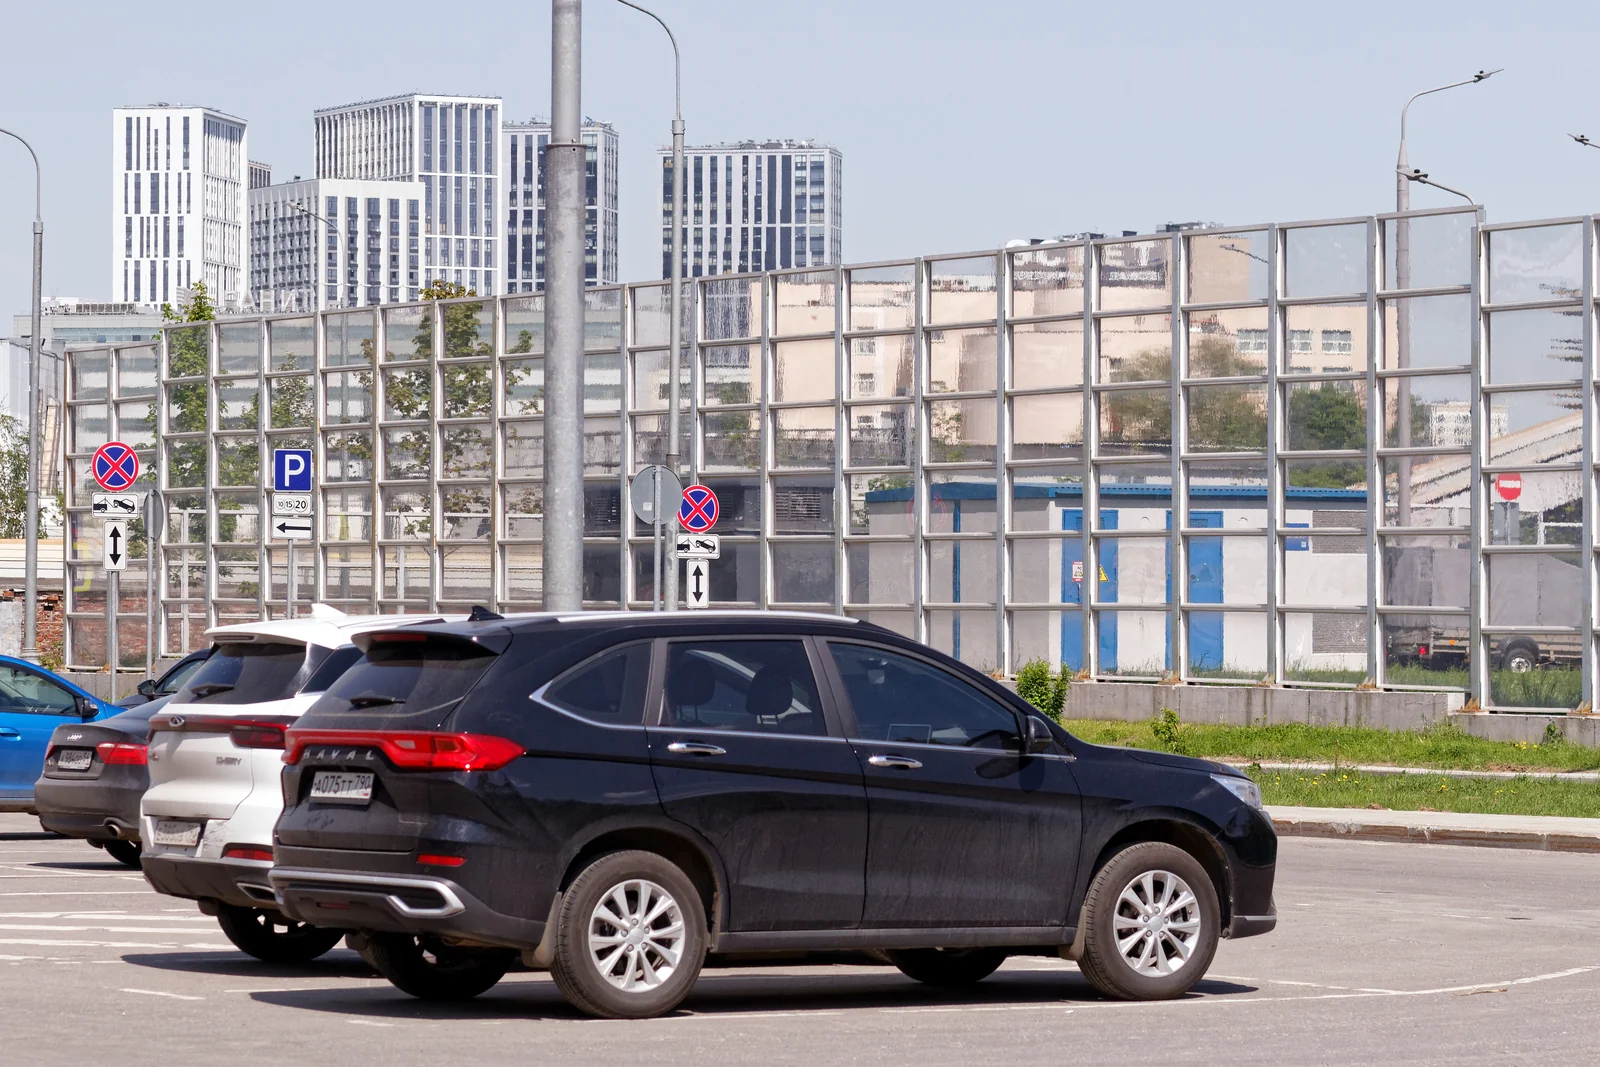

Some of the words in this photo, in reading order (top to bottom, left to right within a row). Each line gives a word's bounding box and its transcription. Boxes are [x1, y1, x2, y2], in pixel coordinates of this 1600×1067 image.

[284, 454, 305, 487] P
[286, 500, 293, 509] 15
[295, 500, 307, 509] 20
[303, 749, 374, 760] HAVAL
